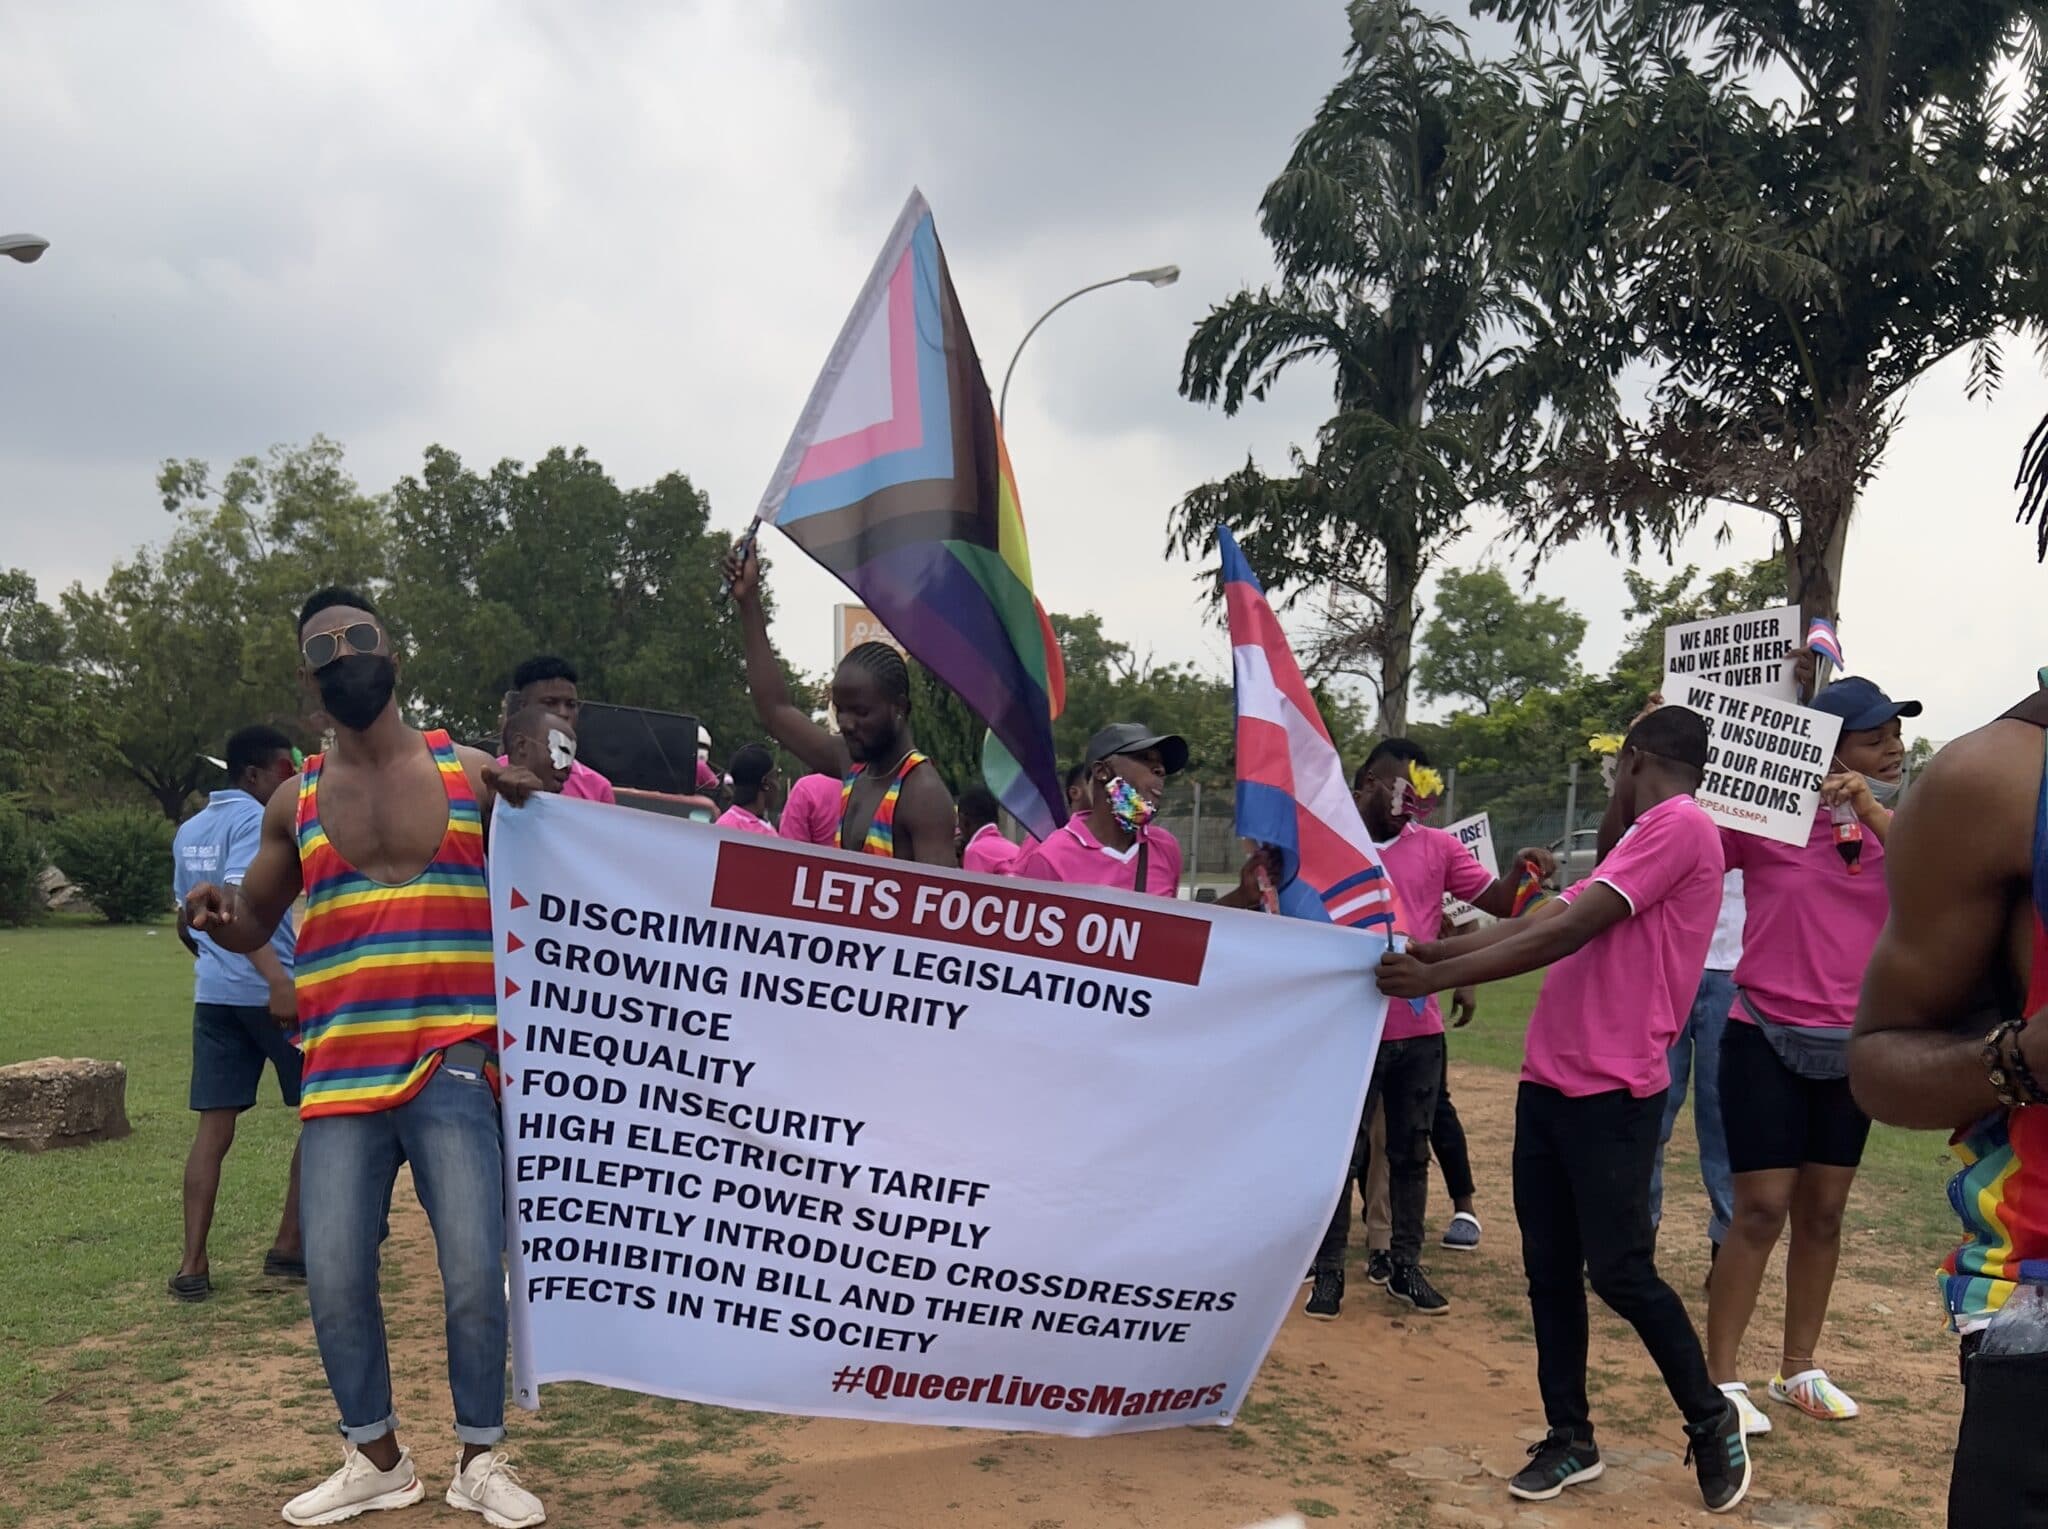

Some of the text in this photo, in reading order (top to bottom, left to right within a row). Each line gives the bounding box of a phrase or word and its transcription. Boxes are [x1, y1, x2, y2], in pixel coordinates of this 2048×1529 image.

[1669, 655, 1695, 673] AND
[1699, 650, 1720, 671] WE
[1723, 645, 1749, 667] ARE
[1680, 619, 1779, 650] WE ARE QUEER
[1725, 666, 1761, 687] OVER
[1766, 664, 1782, 683] IT
[1688, 687, 1811, 739] WE THE PEOPLE,
[1720, 721, 1824, 767] UNSUBDUED,
[1722, 750, 1757, 775] OUR
[1760, 758, 1823, 792] RIGHTS
[792, 866, 1141, 960] LETS FOCUS ON
[534, 937, 969, 1030] GROWING INSECURITY
[539, 893, 1153, 1018] DISCRIMINATORY LEGISLATIONS
[530, 979, 733, 1042] INJUSTICE
[525, 1024, 756, 1088] INEQUALITY
[521, 1068, 866, 1147] FOOD INSECURITY
[518, 1112, 990, 1207] HIGH ELECTRICITY TARIFF
[516, 1154, 991, 1250] EPILEPTIC POWER SUPPLY
[518, 1196, 1238, 1312] RECENTLY INTRODUCED CROSSDRESSERS
[528, 1276, 939, 1354] FFECTS IN THE SOCIETY
[755, 1267, 832, 1304] BILL
[838, 1284, 915, 1316] AND
[925, 1296, 1024, 1329] THEIR
[1031, 1309, 1192, 1343] NEGATIVE
[831, 1365, 1227, 1417] #QueerLivesMatters
